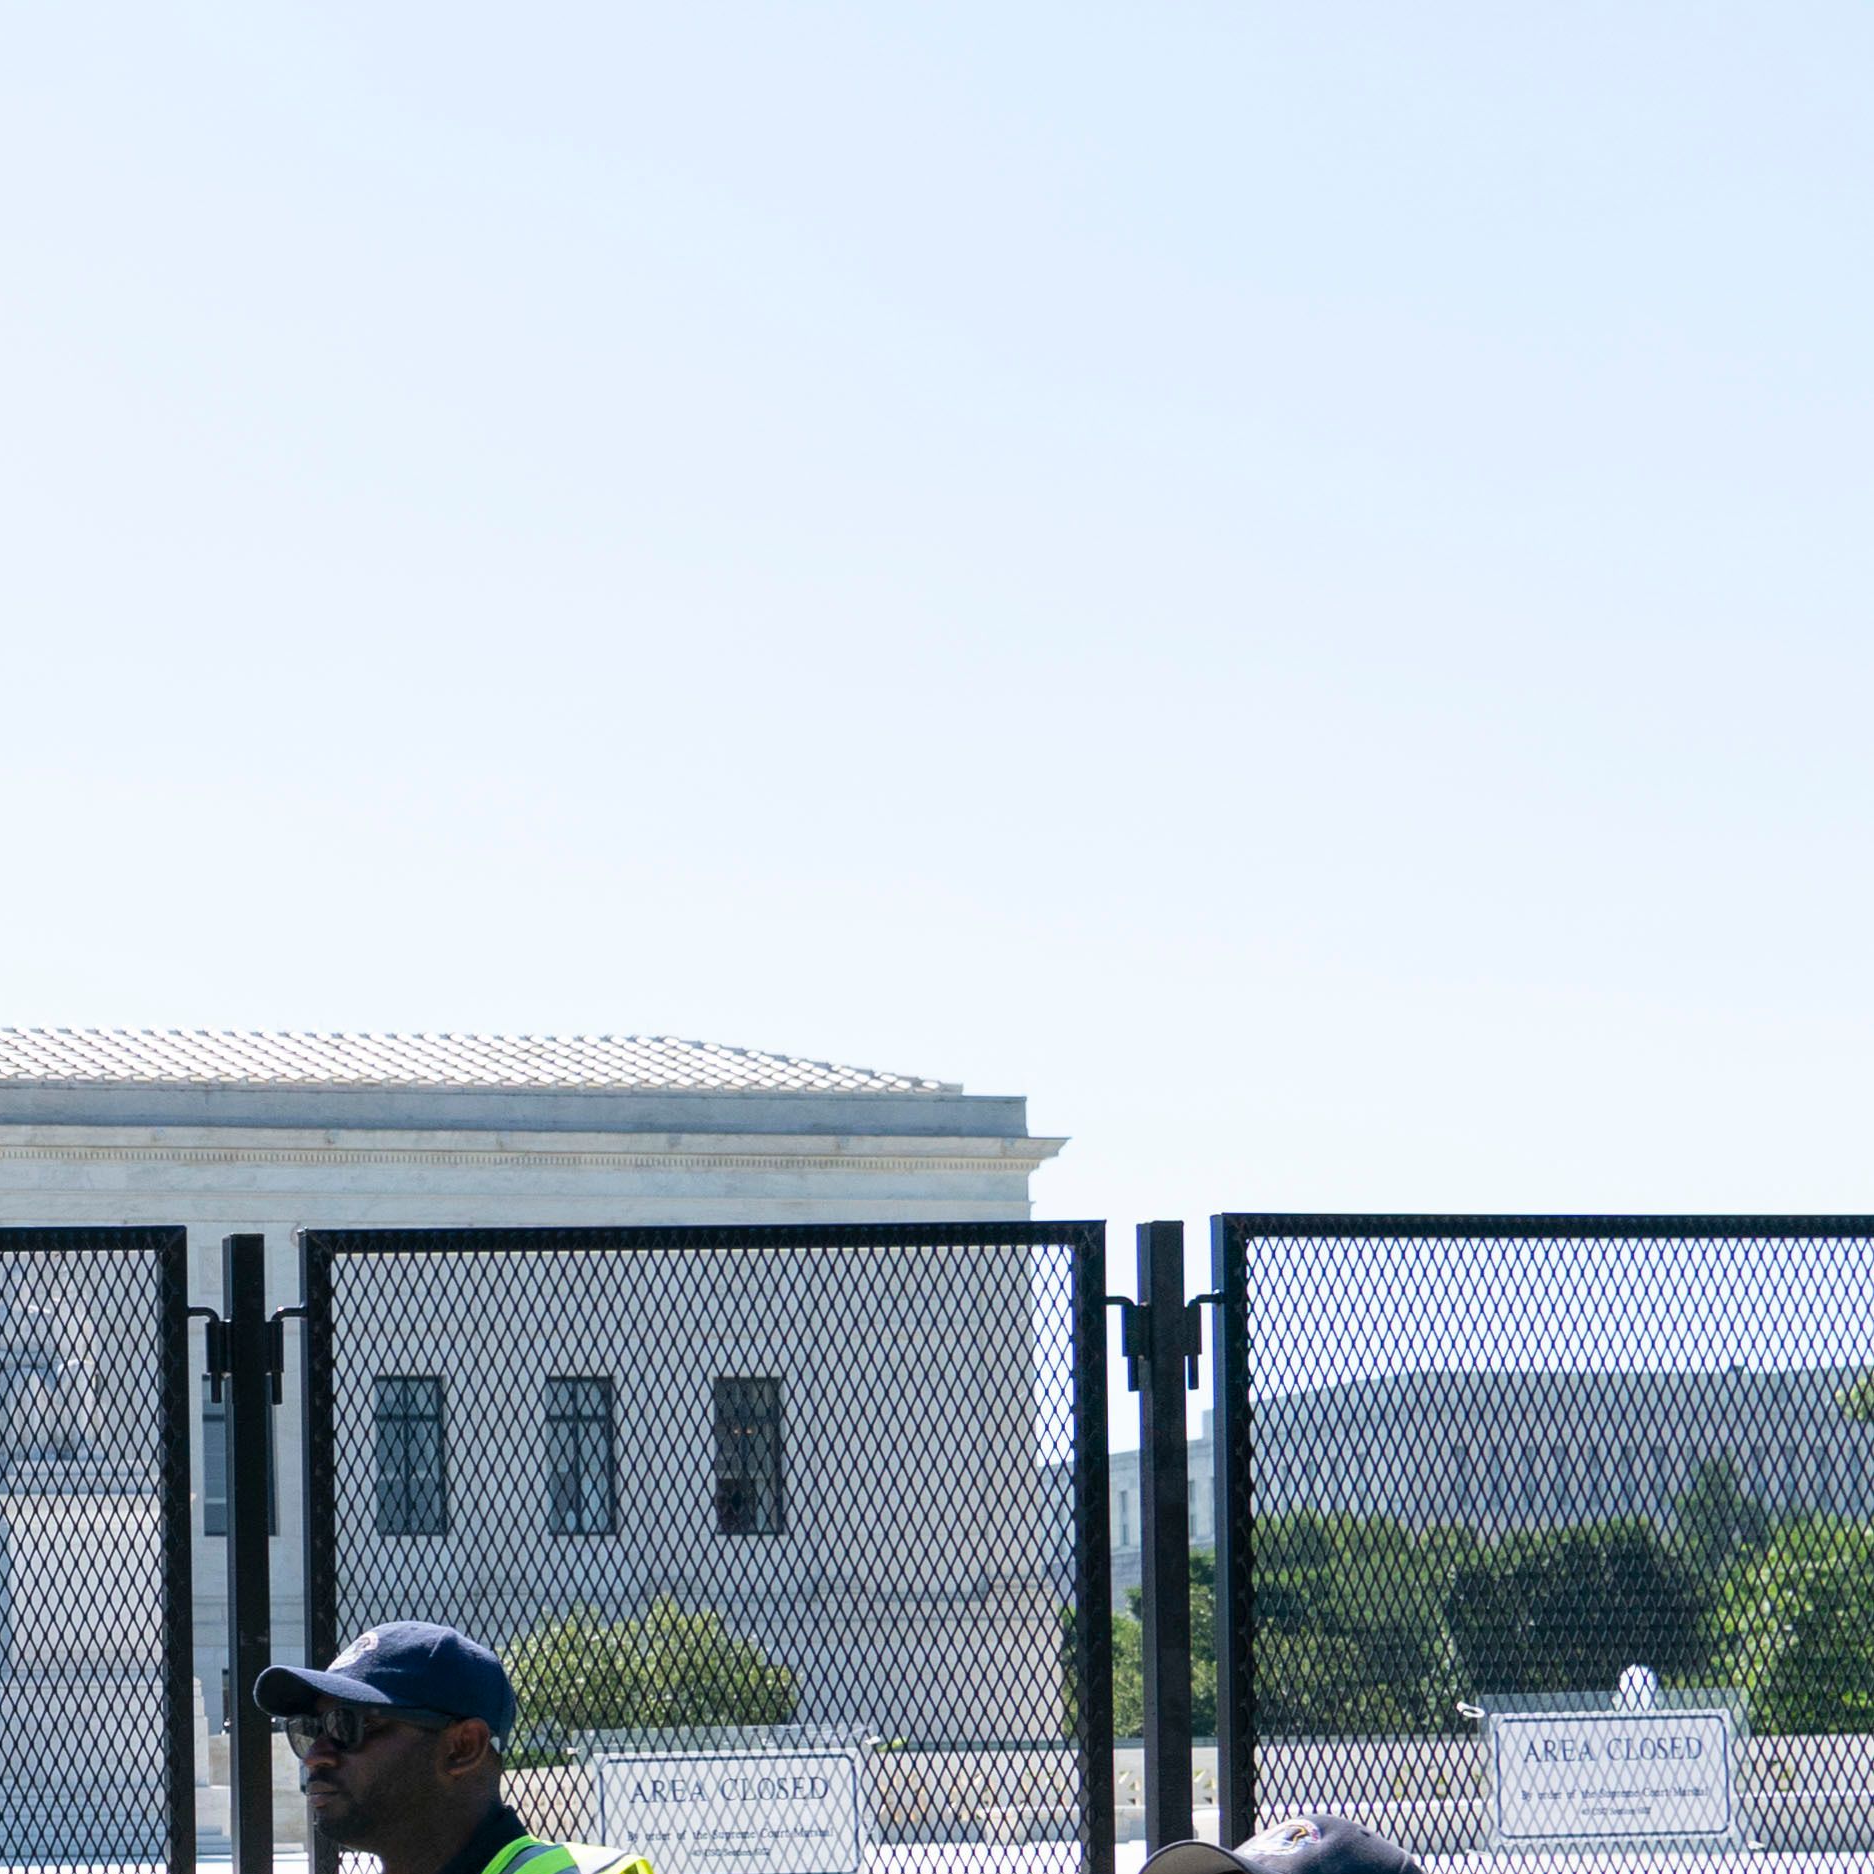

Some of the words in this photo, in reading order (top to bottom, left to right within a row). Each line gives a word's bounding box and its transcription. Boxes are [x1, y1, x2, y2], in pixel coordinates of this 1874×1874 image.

[1523, 1739, 1595, 1763] AREA
[1607, 1736, 1703, 1761] CLOSED
[630, 1778, 707, 1804] AREA
[720, 1776, 829, 1801] CLOSED
